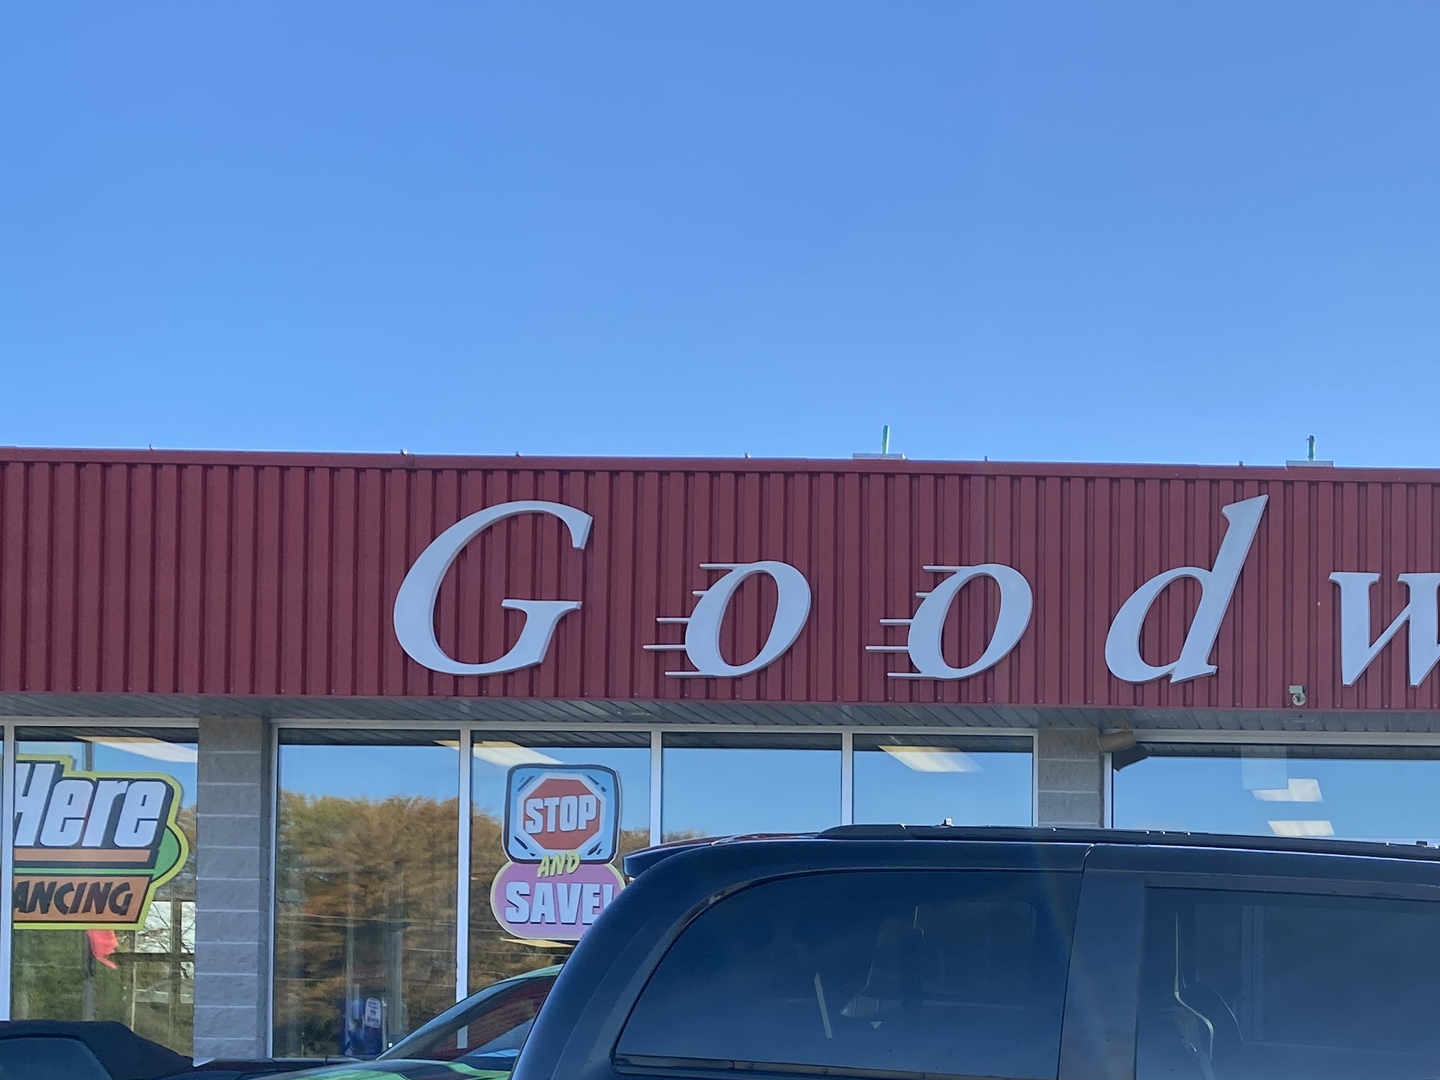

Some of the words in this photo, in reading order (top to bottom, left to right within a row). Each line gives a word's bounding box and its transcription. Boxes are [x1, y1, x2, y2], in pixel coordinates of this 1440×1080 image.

[14, 763, 167, 847] Here
[524, 794, 597, 835] STOP
[537, 851, 580, 878] AND
